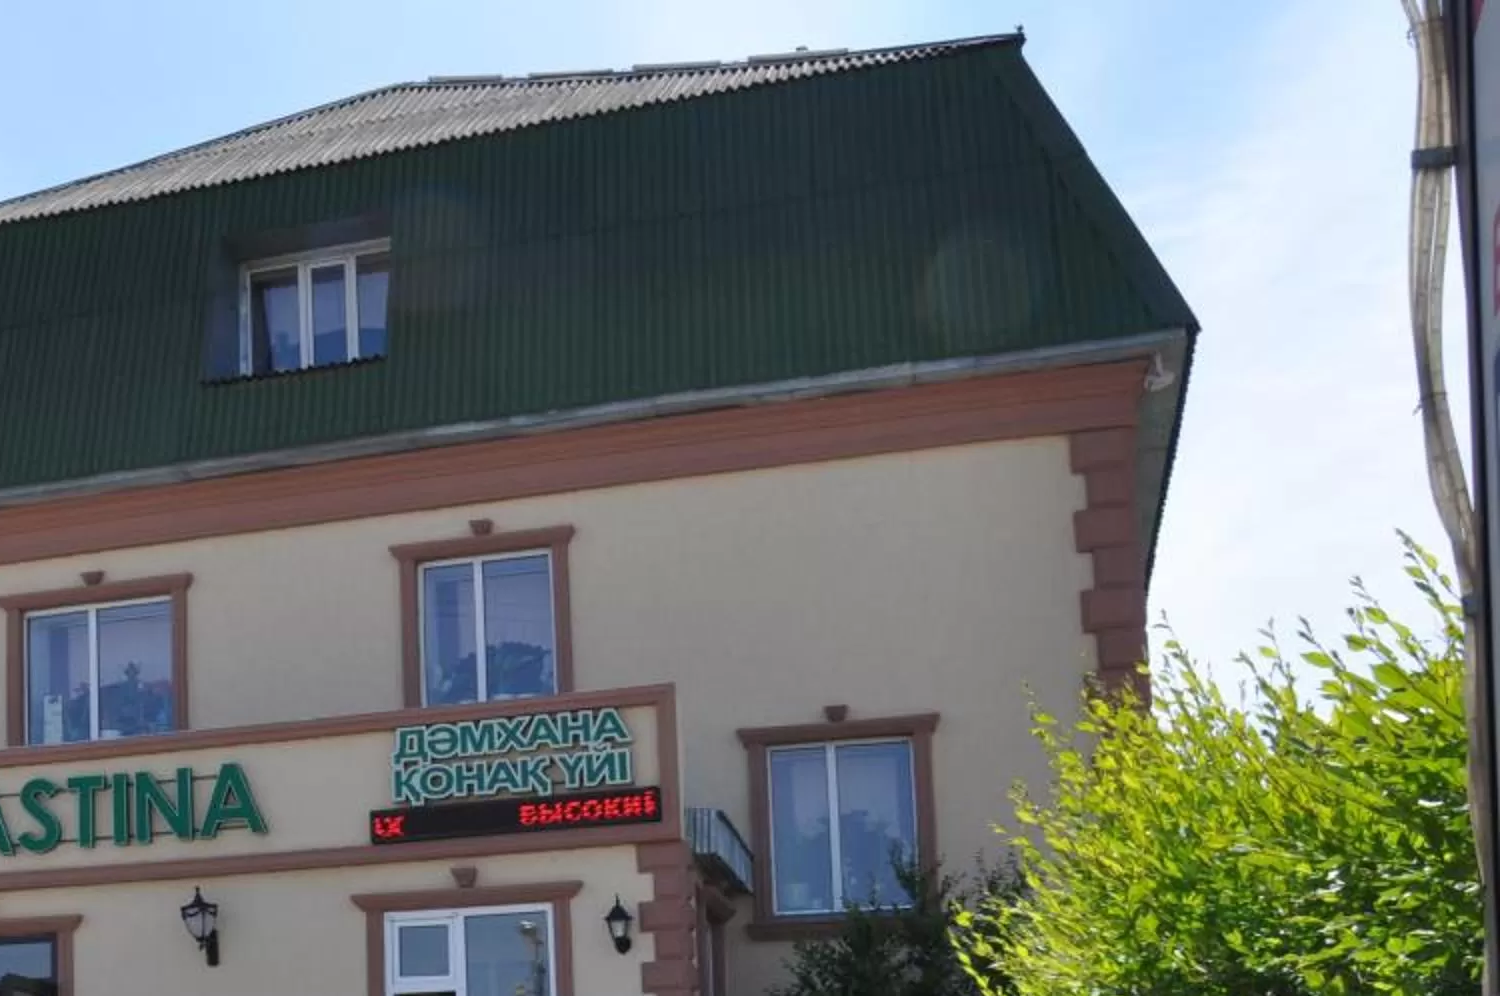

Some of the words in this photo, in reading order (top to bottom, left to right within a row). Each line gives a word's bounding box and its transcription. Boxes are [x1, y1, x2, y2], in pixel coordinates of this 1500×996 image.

[393, 707, 630, 765] ДӘМХАНА
[393, 754, 552, 806] ҚОНАҚ
[558, 745, 635, 788] ҮЙІ
